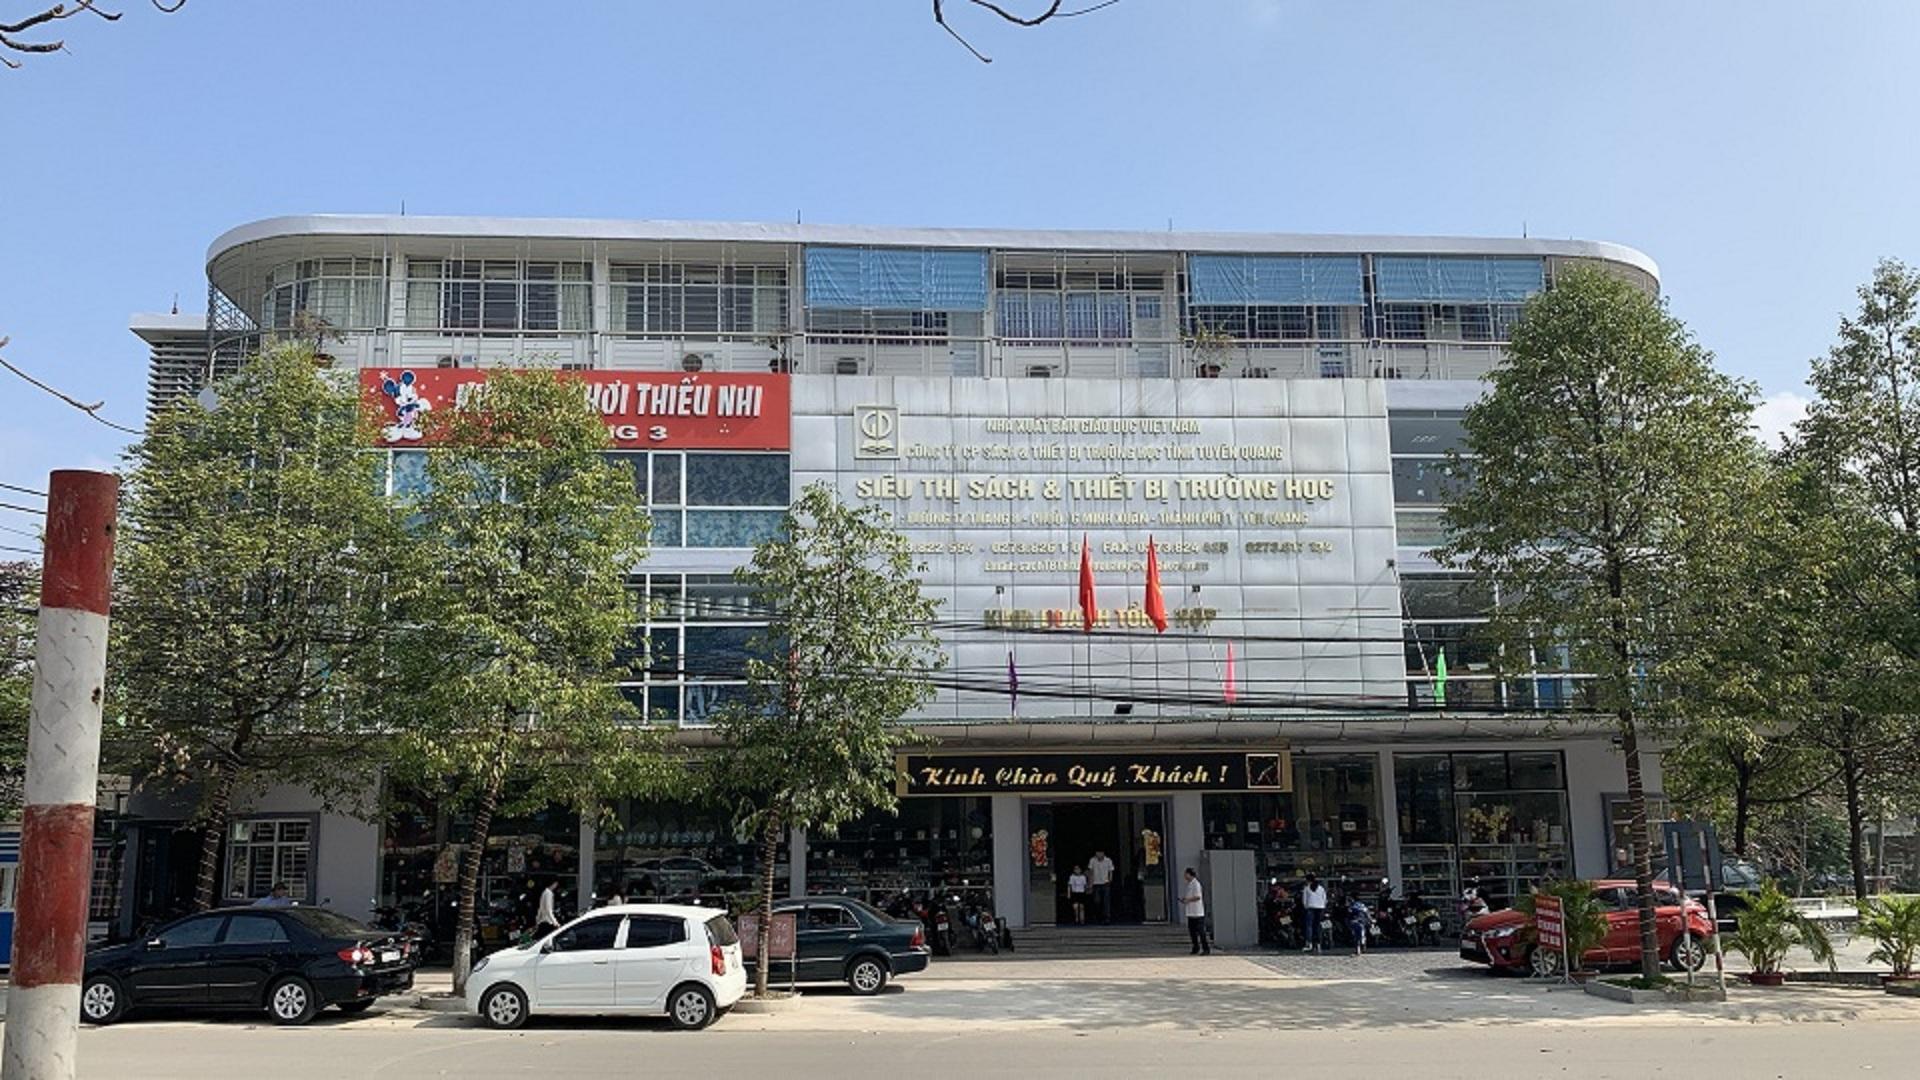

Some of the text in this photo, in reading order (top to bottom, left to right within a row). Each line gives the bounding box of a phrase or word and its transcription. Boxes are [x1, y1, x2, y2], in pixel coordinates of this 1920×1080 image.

[584, 380, 629, 416] HƠI
[637, 375, 712, 416] THIẾU
[716, 384, 763, 416] NHI
[648, 425, 668, 441] 3
[1171, 418, 1200, 434] NAM
[1018, 446, 1029, 460] &
[1240, 446, 1283, 462] QUANG
[856, 472, 1335, 504] SIÊU THỊ SÁCH & THIẾT BỊ TRƯỜNG HỌC
[1031, 509, 1079, 525] PHƯỜG
[1102, 542, 1132, 555] FAX:
[1135, 542, 1199, 554] 073.824
[1040, 608, 1110, 629] DOAH
[1114, 601, 1168, 629] TỔN
[920, 766, 986, 786] Kính
[996, 766, 1058, 786] Chào
[1067, 764, 1117, 787] Quý
[1127, 763, 1209, 784] Khách
